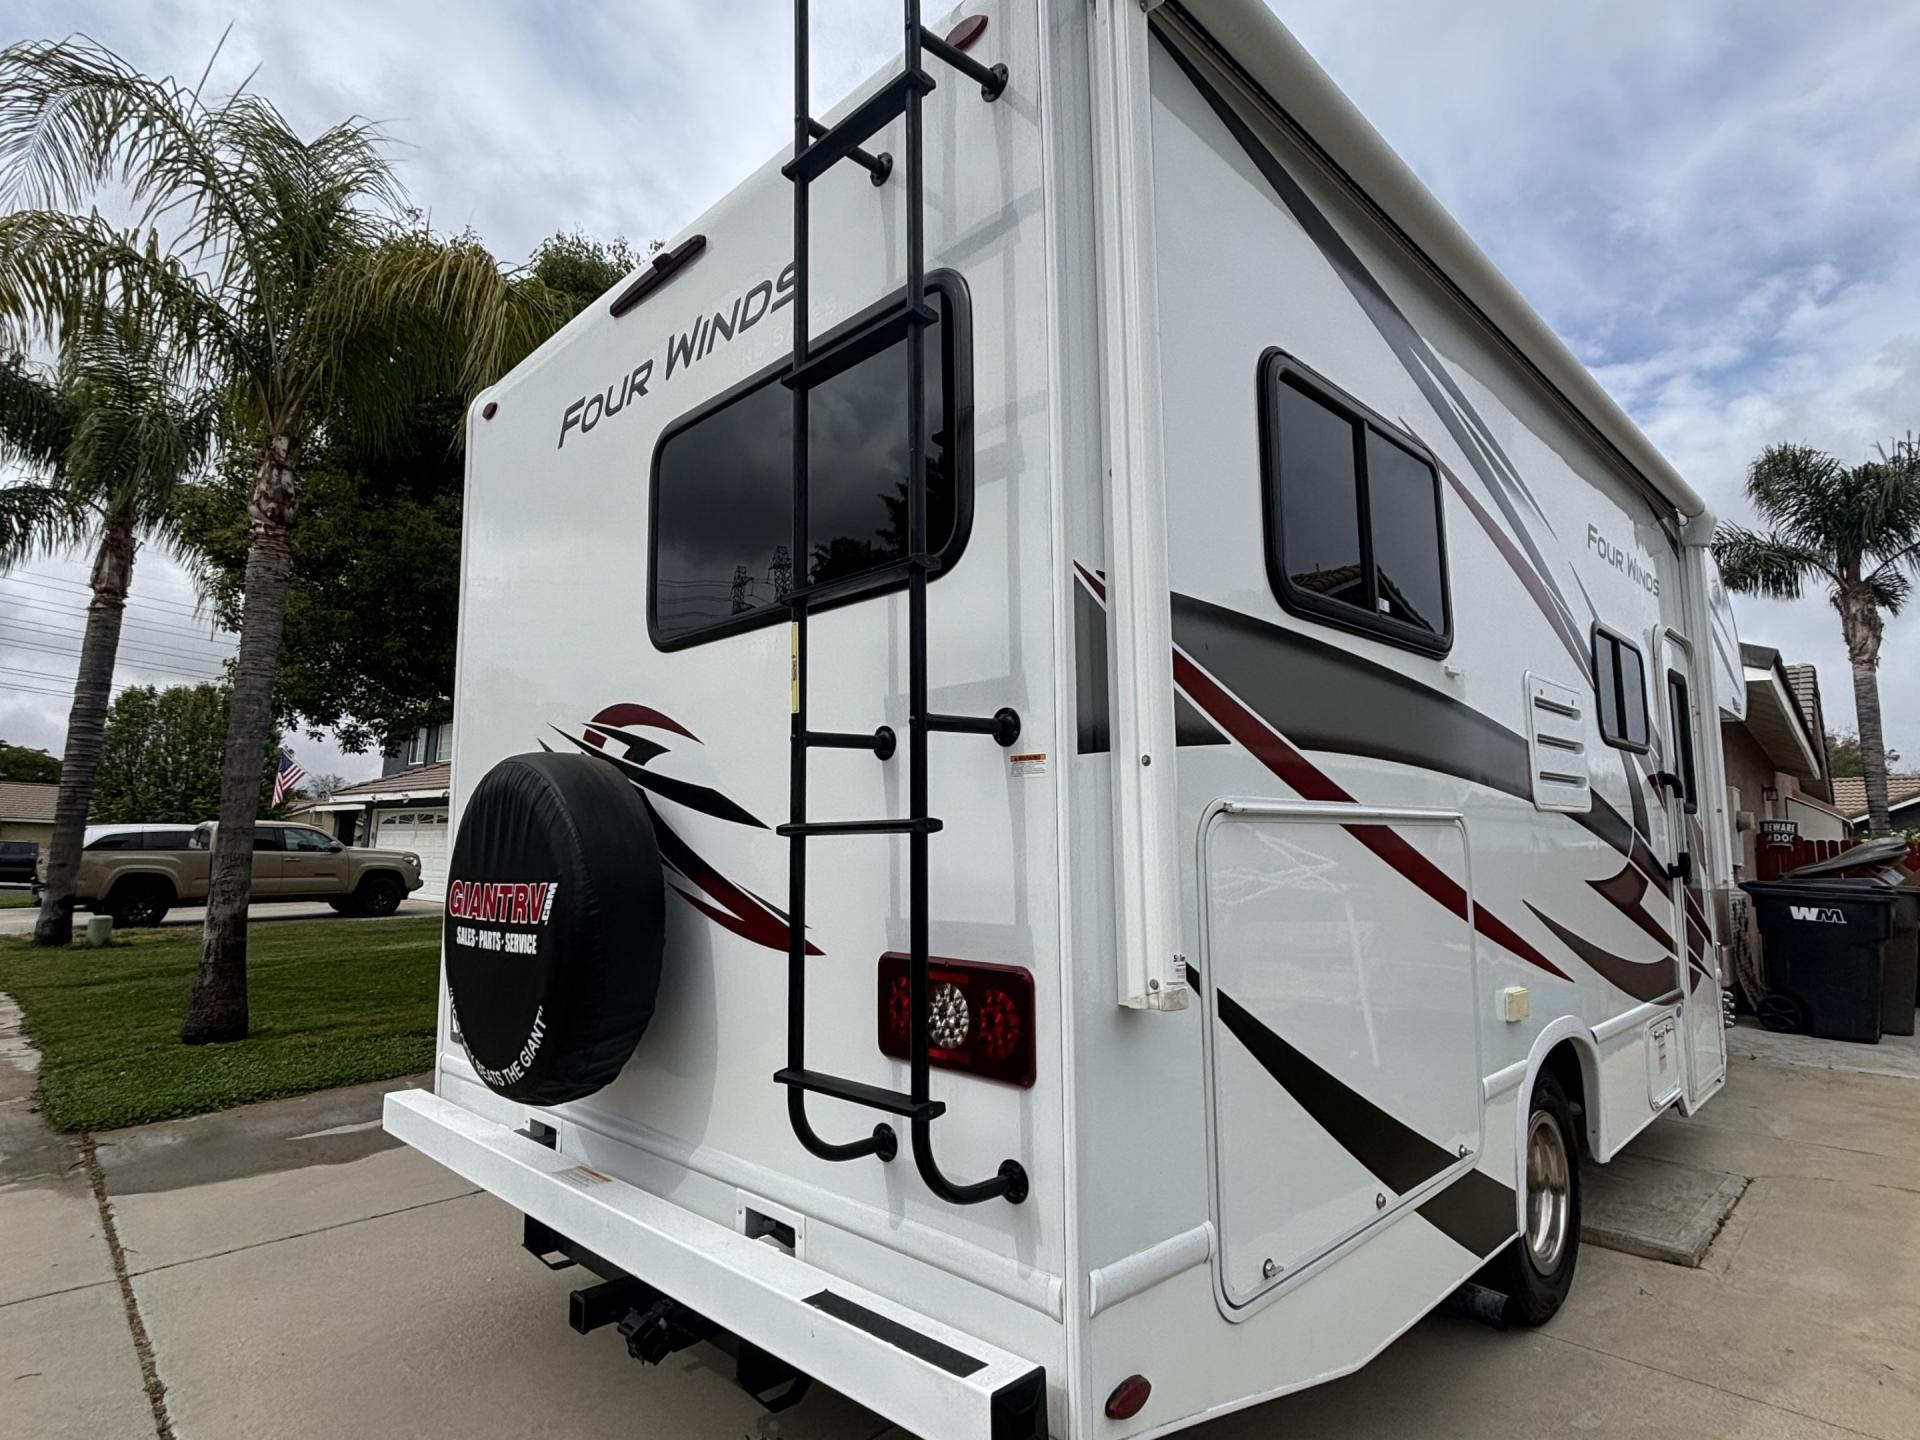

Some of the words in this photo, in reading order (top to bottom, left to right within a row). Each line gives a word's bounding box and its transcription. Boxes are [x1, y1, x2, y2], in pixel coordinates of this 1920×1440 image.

[557, 358, 654, 450] FOUR
[665, 261, 795, 382] WINDS
[1587, 522, 1624, 573] FOUR
[1626, 551, 1660, 598] WINDS
[1763, 823, 1795, 832] BEWARE
[1789, 905, 1848, 925] WM
[456, 926, 476, 948] SALES
[478, 929, 501, 952] PARTS
[504, 932, 538, 955] SERVICE
[501, 1059, 525, 1085] THE
